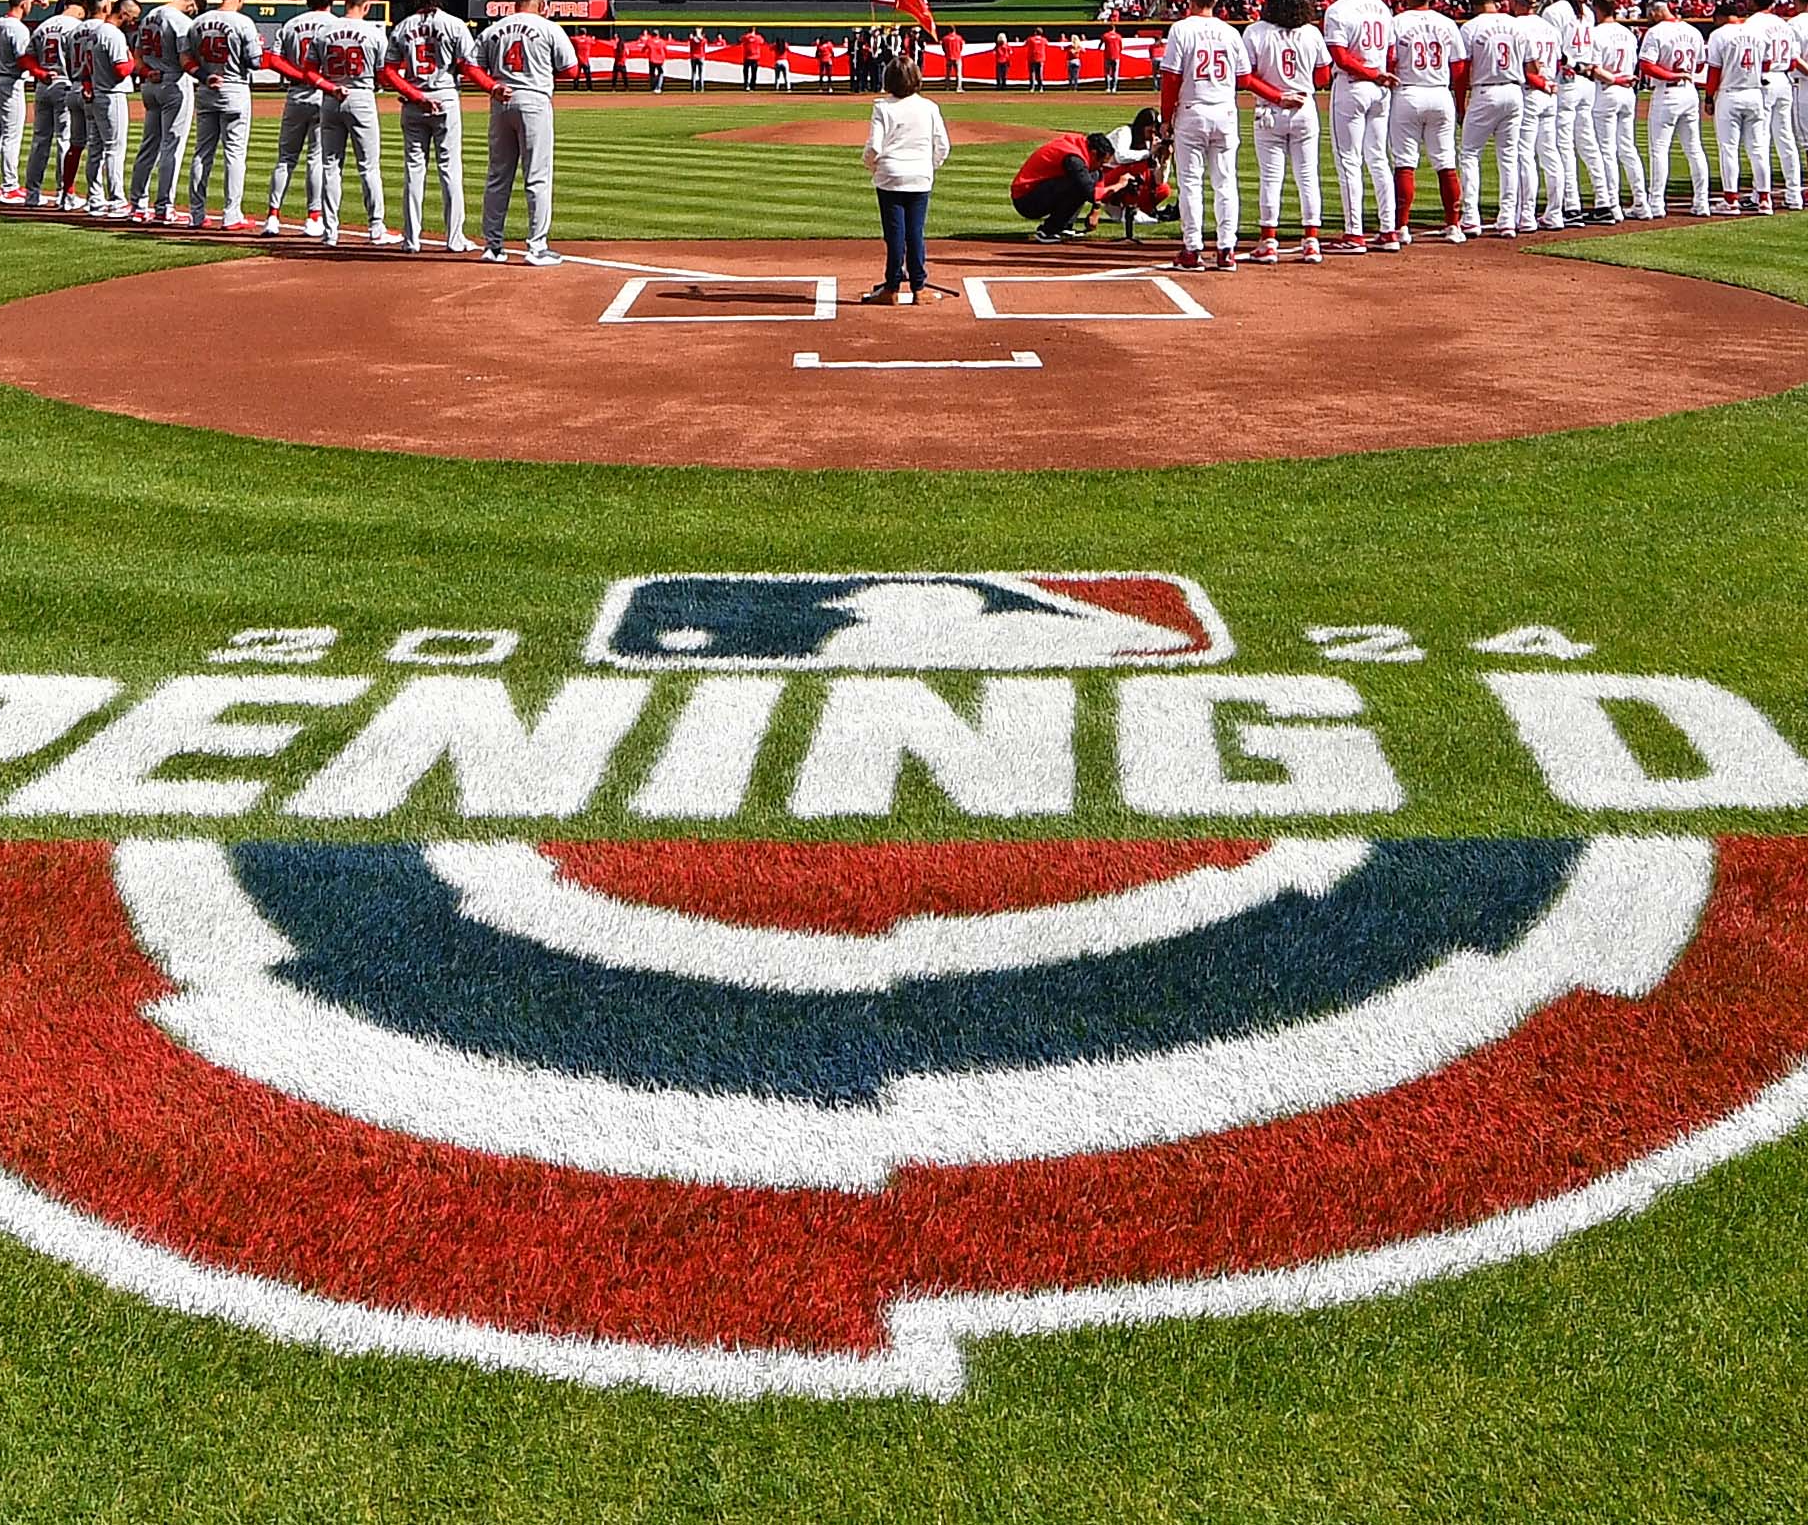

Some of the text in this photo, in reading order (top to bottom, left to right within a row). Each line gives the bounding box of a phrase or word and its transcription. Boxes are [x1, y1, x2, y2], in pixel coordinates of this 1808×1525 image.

[198, 35, 229, 64] 45
[327, 29, 368, 44] THOMAS
[1361, 20, 1384, 50] 30
[1571, 26, 1592, 53] 44
[44, 38, 59, 64] 2
[326, 44, 365, 77] 28
[415, 42, 437, 75] 5
[503, 40, 524, 72] 4
[1195, 49, 1228, 82] 25
[1281, 48, 1296, 79] 6
[1413, 41, 1442, 71] 33
[1497, 41, 1511, 71] 3
[1614, 48, 1626, 74] 7
[1672, 48, 1695, 74] 23
[1740, 48, 1754, 71] 4
[1772, 39, 1790, 63] 12
[207, 623, 1595, 667] 20 24
